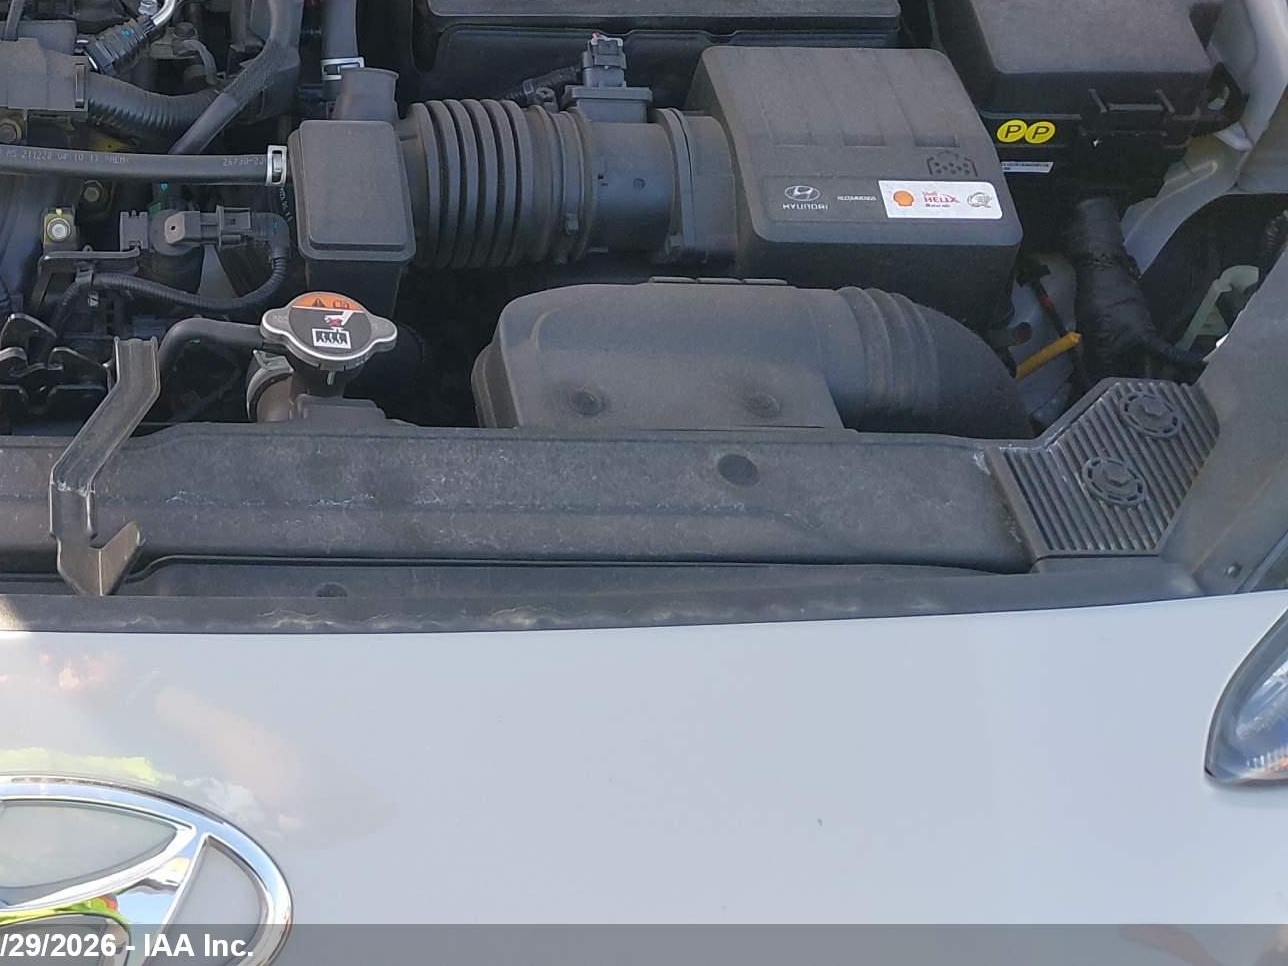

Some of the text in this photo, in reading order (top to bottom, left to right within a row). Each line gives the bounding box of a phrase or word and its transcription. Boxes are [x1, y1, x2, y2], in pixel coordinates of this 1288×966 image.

[1005, 124, 1050, 140] P P
[923, 195, 960, 203] HELIX
